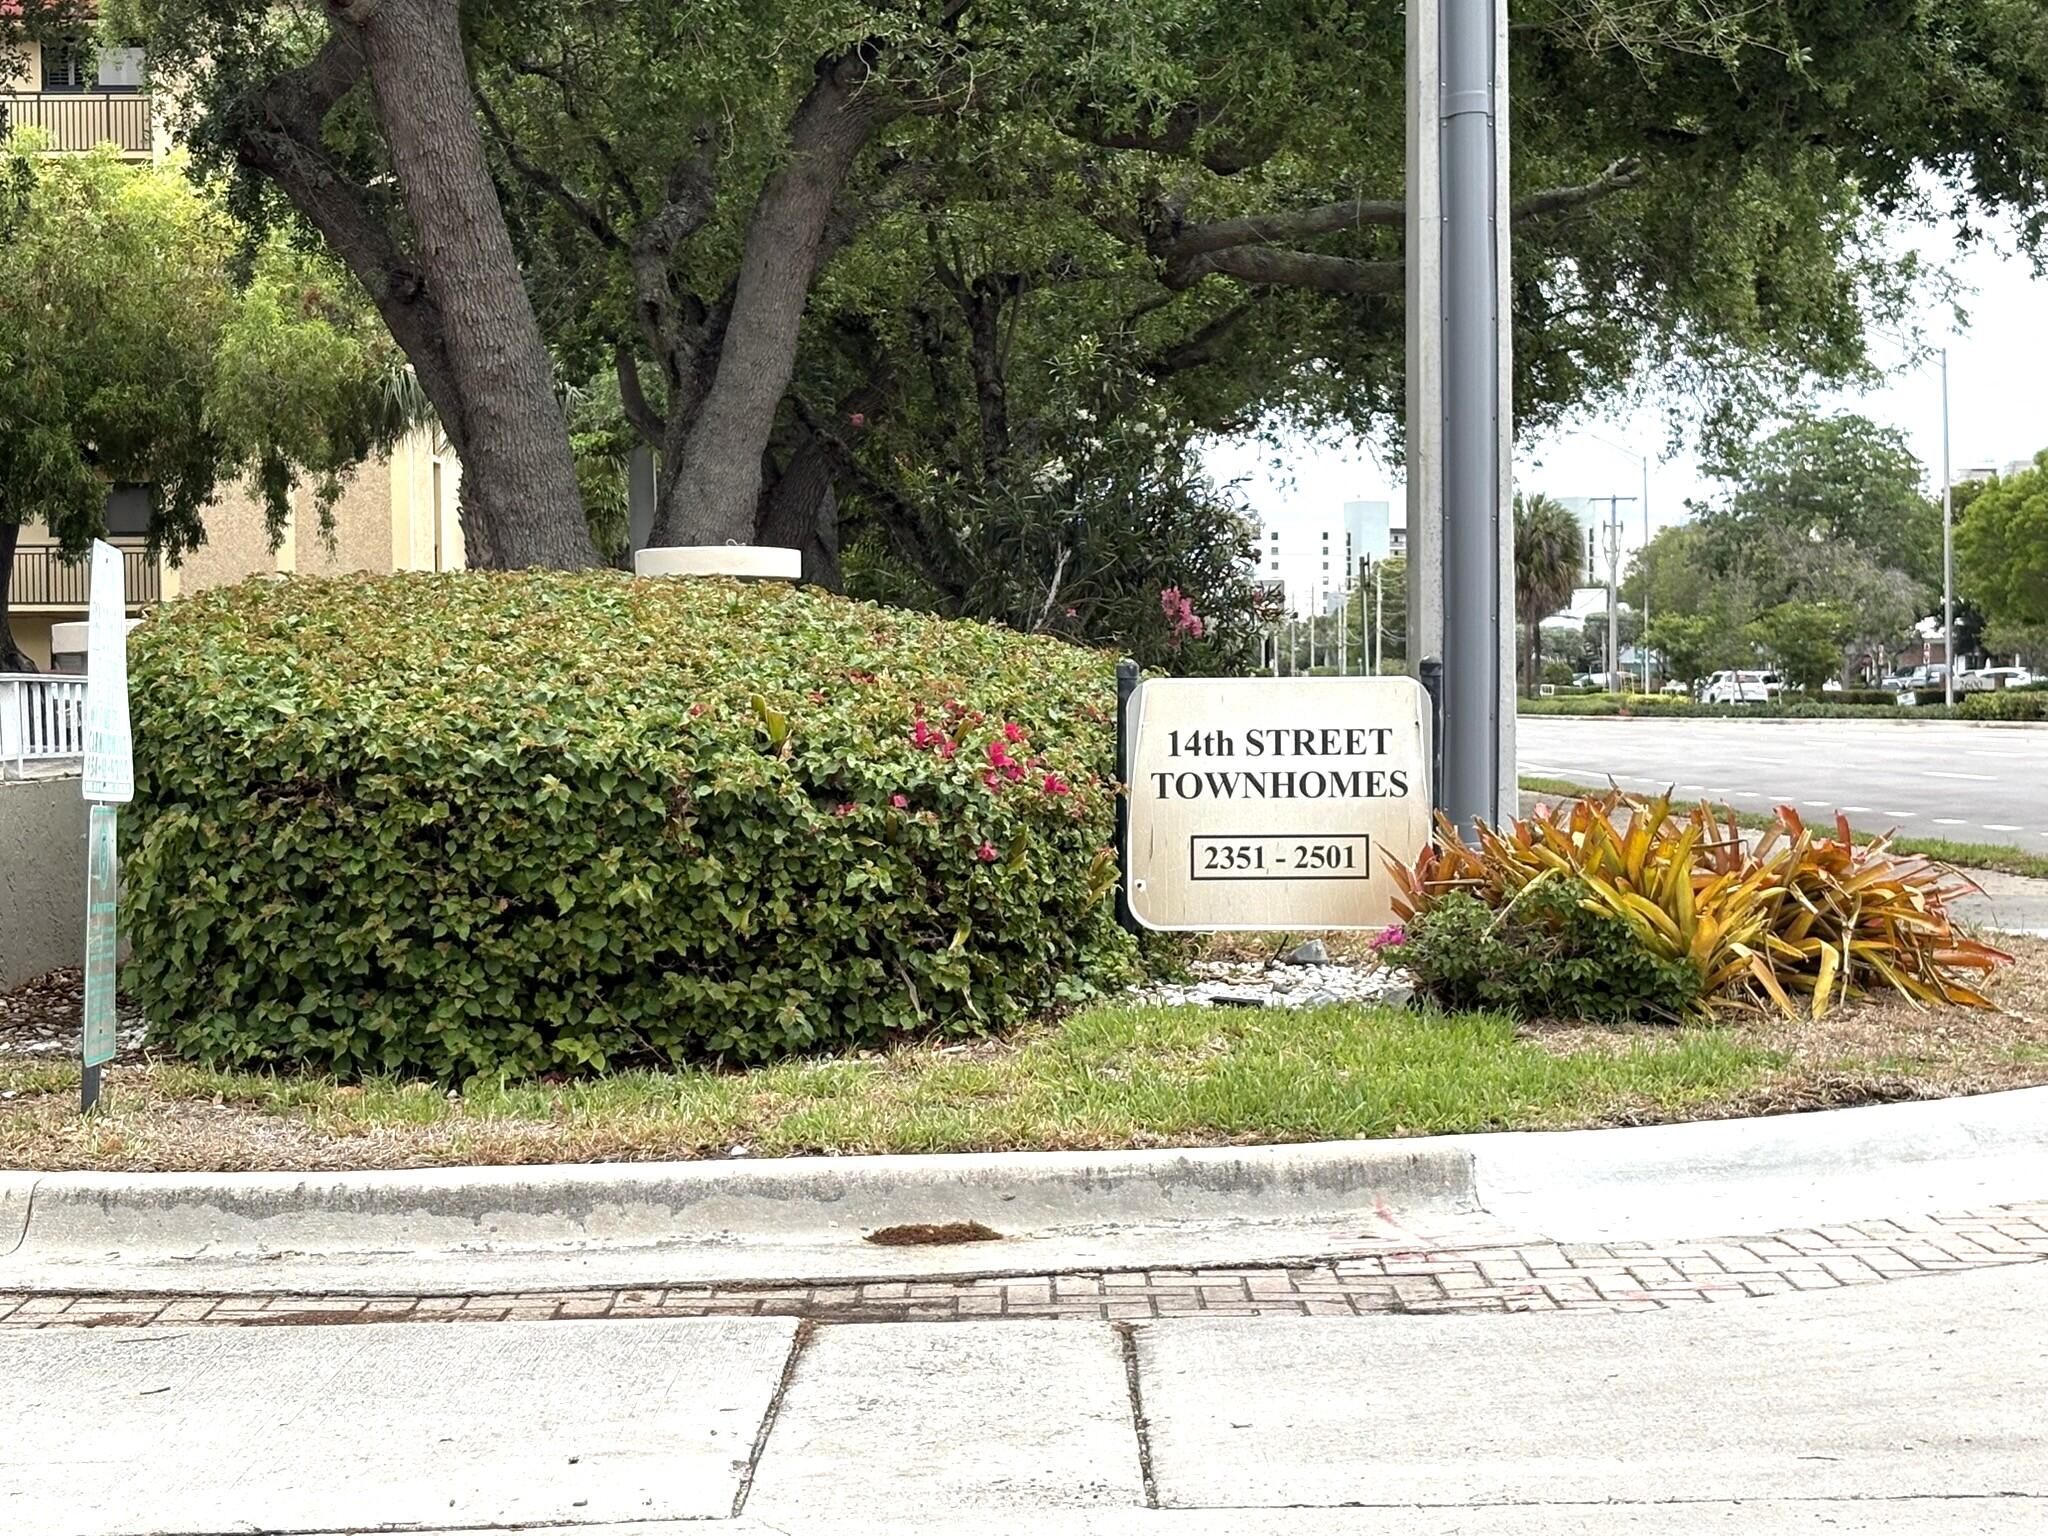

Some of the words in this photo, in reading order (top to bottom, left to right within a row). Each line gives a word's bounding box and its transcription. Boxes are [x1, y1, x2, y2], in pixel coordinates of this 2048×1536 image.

[1167, 729, 1235, 757] 14th
[1245, 727, 1393, 757] STREET
[1150, 769, 1409, 800] TOWNHOMES
[1203, 845, 1265, 870] 2351
[1294, 844, 1357, 869] 2501
